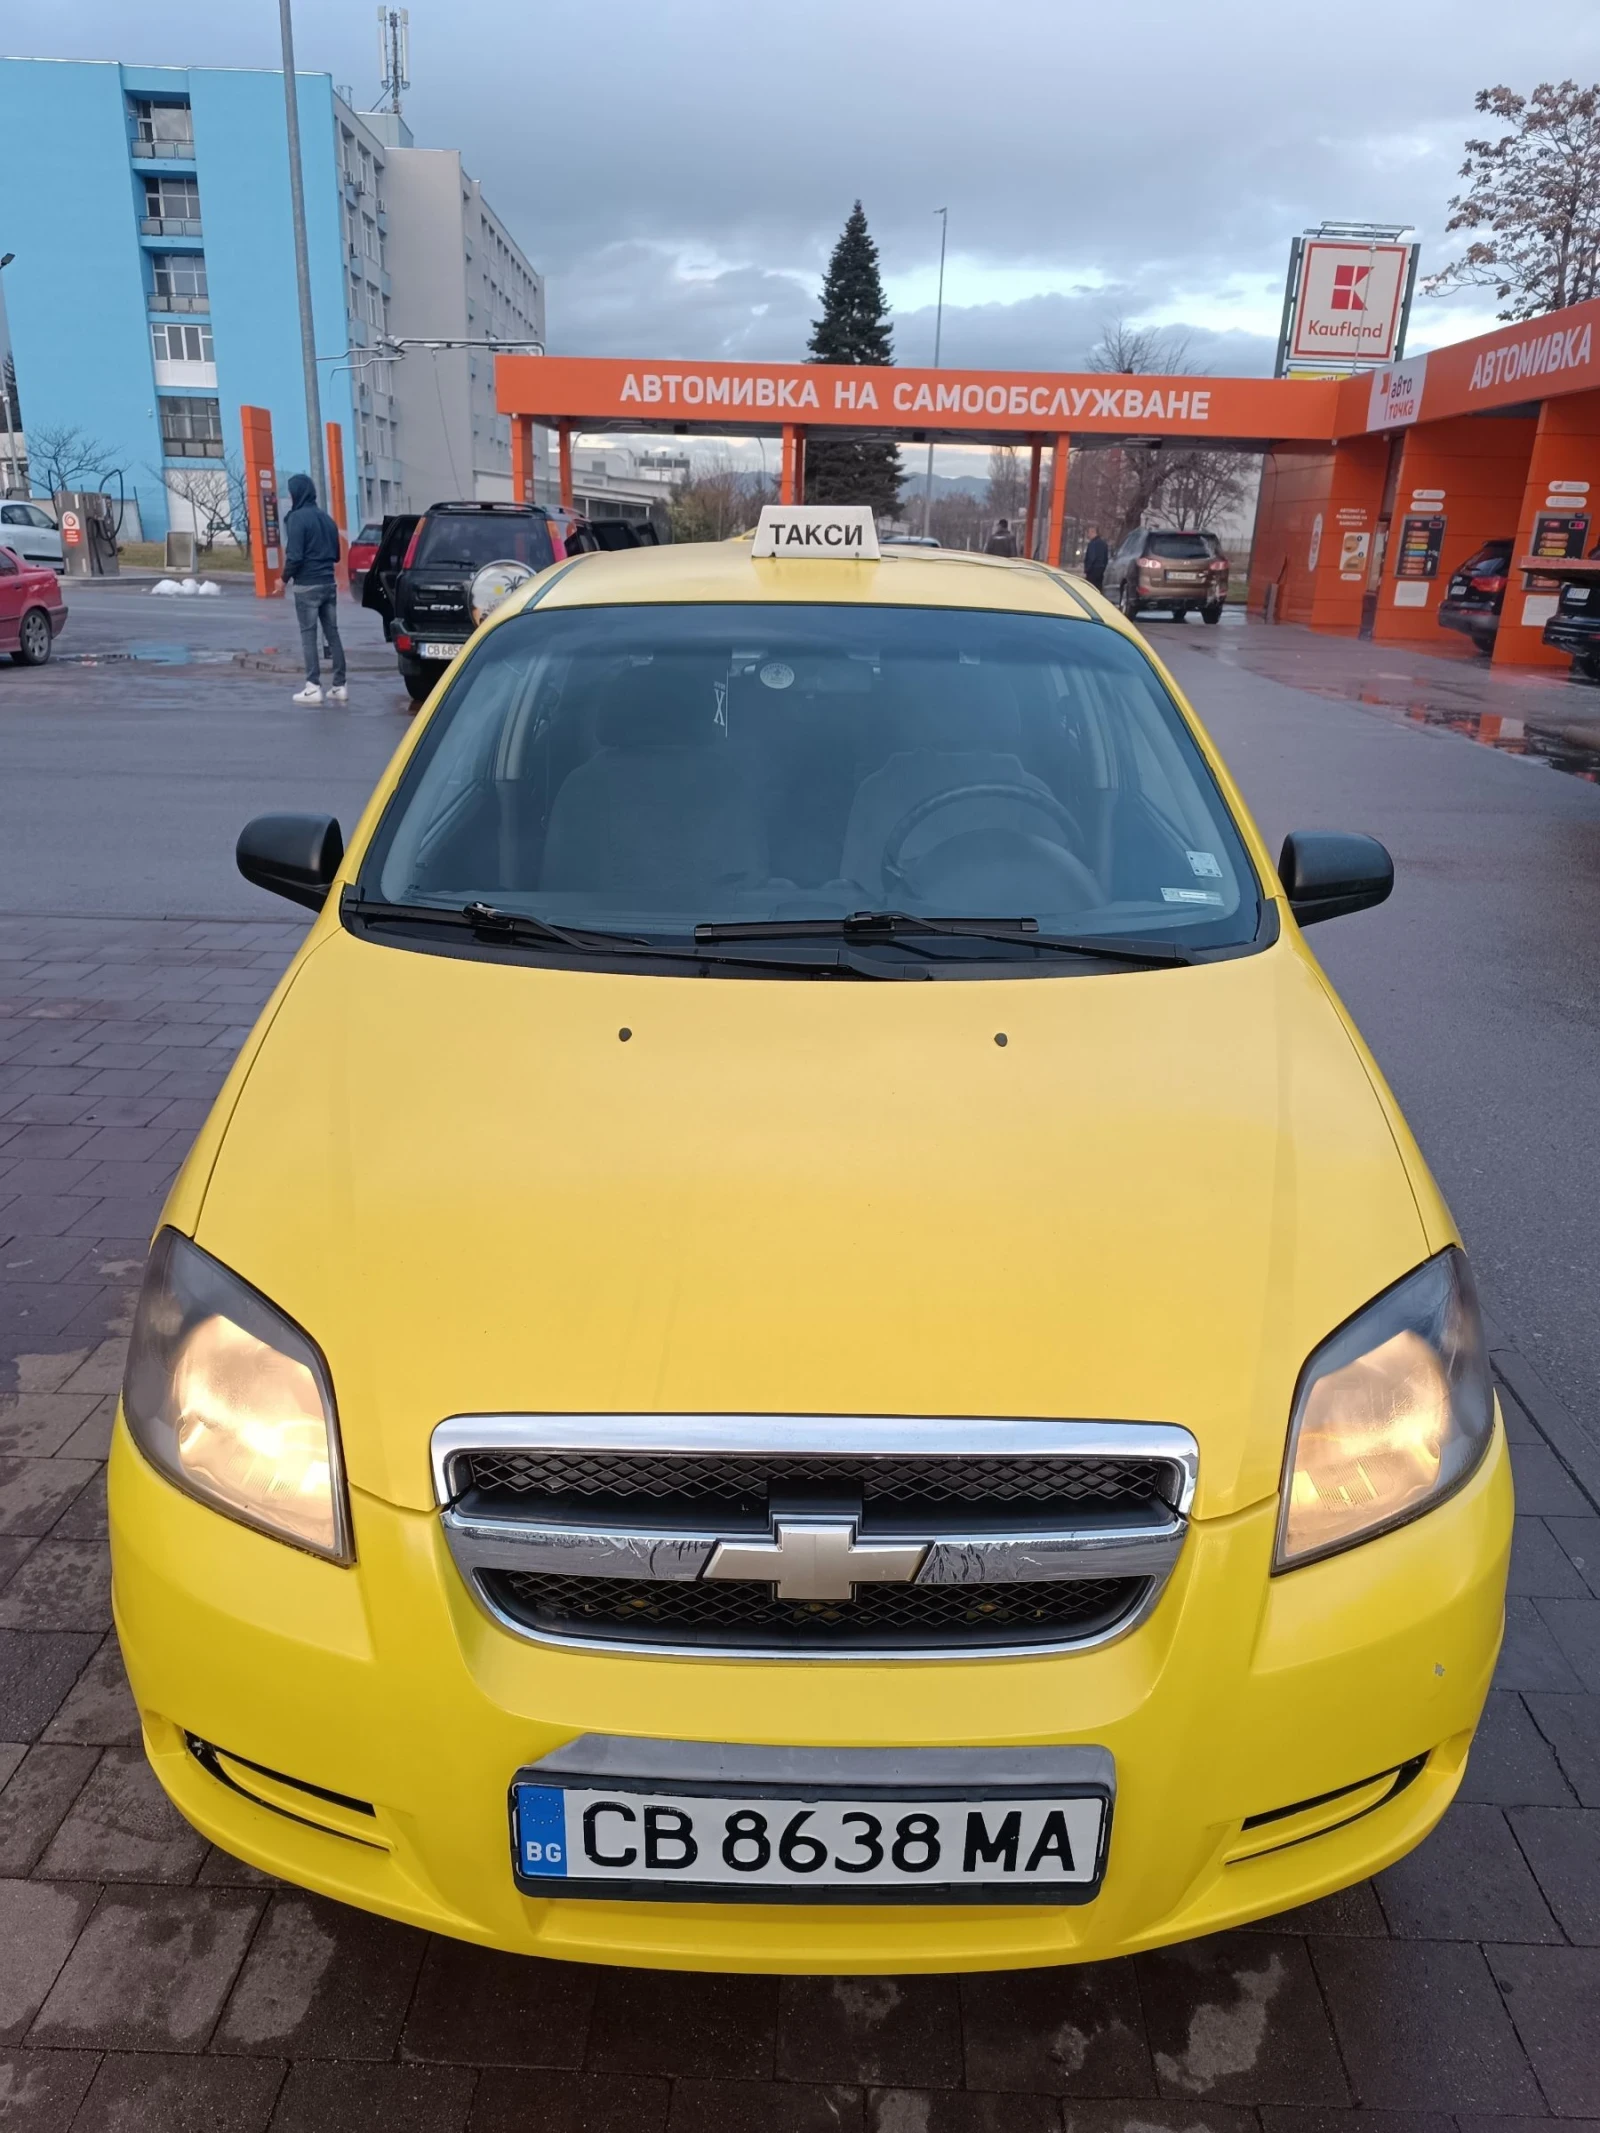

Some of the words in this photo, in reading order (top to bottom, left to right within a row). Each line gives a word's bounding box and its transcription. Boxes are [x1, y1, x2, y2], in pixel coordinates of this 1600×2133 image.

[1308, 320, 1383, 338] Kaufland
[1468, 323, 1592, 391] АВТОМИВКА
[620, 373, 819, 408] АВТОМИВКА
[834, 380, 879, 410] НА
[893, 382, 1211, 420] САМООБСЛУЖВАНЕ
[1388, 399, 1414, 420] точка
[769, 523, 862, 546] ТАКСИ
[430, 604, 463, 612] CR-V
[583, 1801, 698, 1869] CB
[722, 1809, 942, 1873] 8638
[963, 1810, 1076, 1872] MA
[526, 1841, 562, 1862] BG
